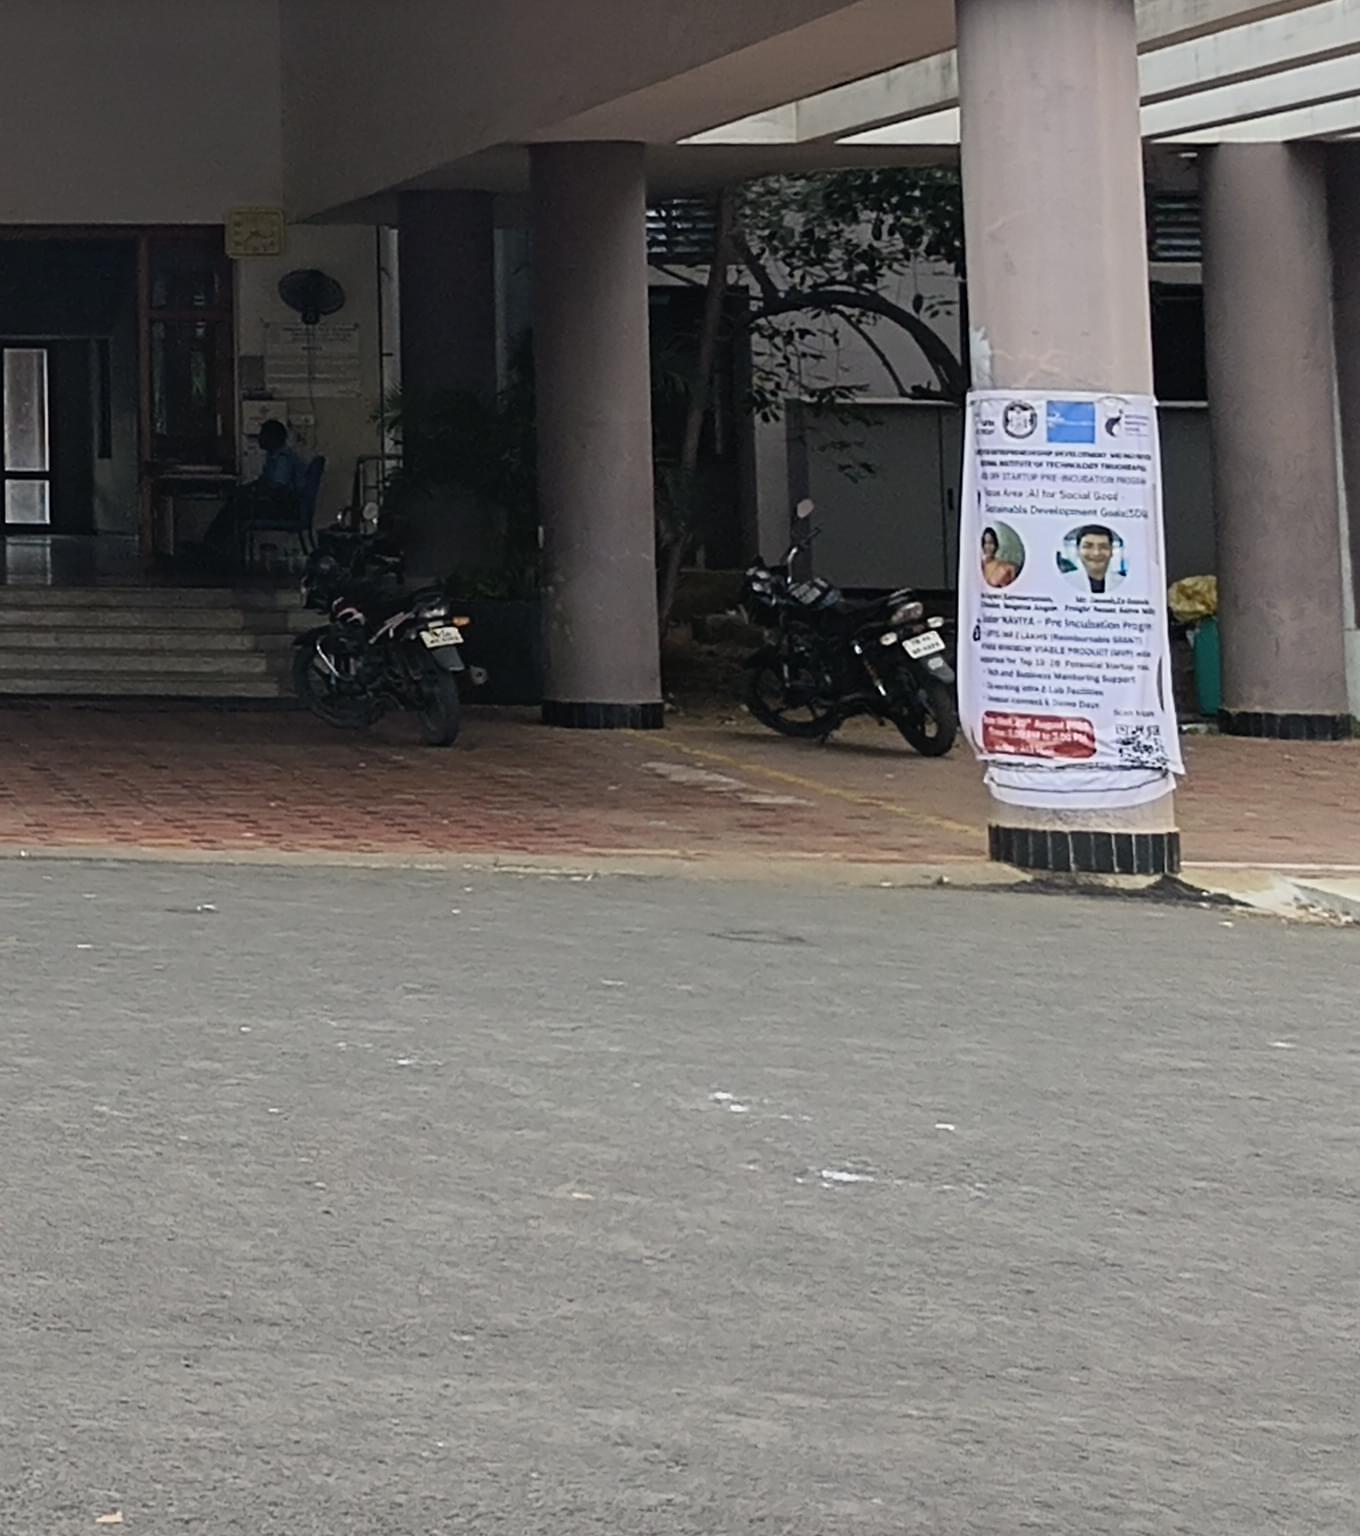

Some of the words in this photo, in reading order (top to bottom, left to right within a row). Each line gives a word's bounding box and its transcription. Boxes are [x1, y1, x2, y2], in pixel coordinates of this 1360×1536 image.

[1059, 489, 1091, 499] Social
[1030, 505, 1097, 517] Development
[1064, 618, 1121, 629] Incubation
[1067, 647, 1109, 657] PRODUCT
[1101, 674, 1136, 684] Support
